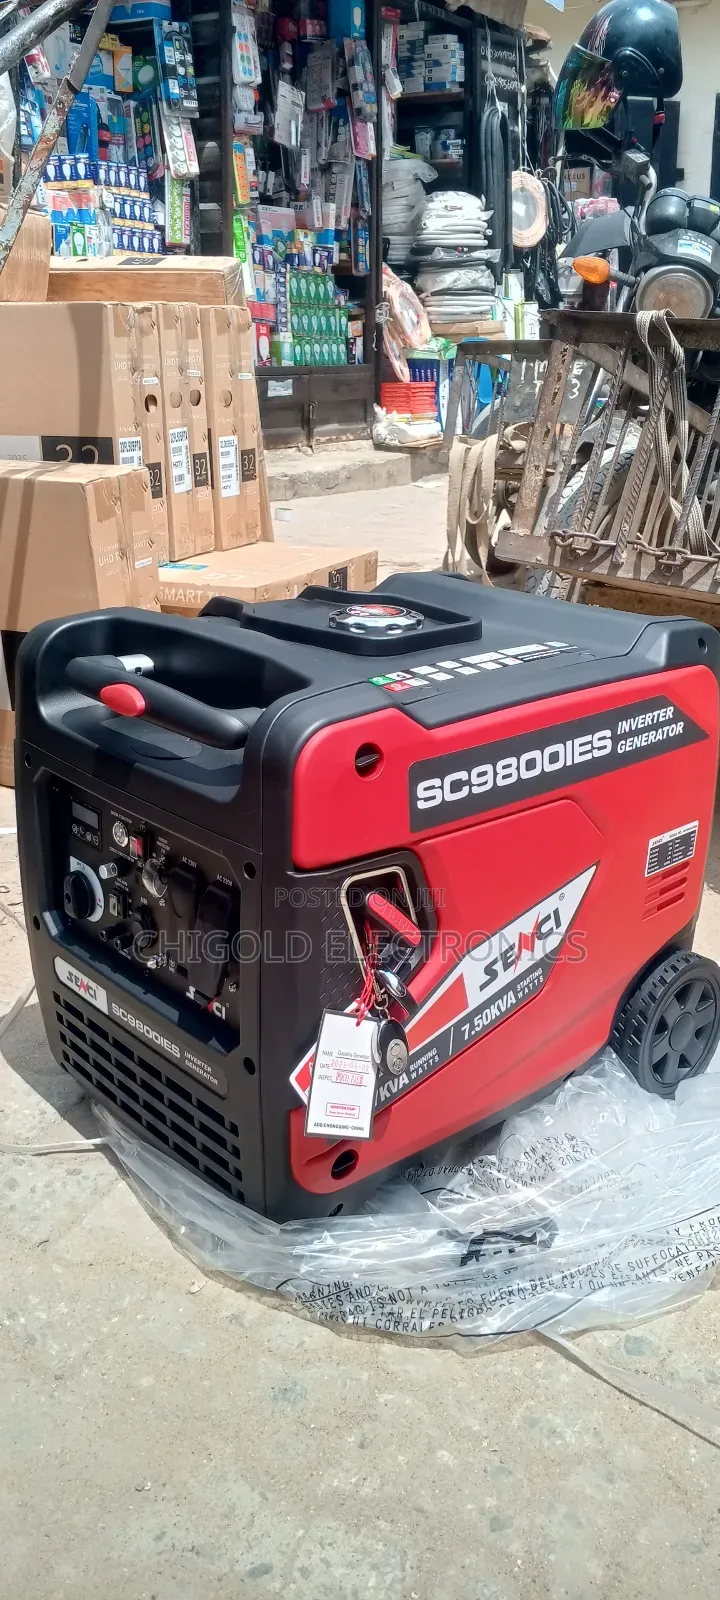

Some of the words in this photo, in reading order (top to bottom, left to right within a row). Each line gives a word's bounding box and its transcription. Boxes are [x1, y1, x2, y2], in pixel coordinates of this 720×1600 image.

[195, 458, 207, 476] 32
[242, 453, 255, 471] 32
[159, 586, 202, 604] SMART
[617, 721, 684, 755] GENERATOR
[416, 729, 612, 810] SC9800IES
[616, 706, 674, 735] INVERTER
[479, 906, 562, 992] SENCI
[66, 970, 98, 1001] SENCI
[516, 967, 543, 992] STARTING
[461, 990, 517, 1041] 7.50KVA
[517, 975, 544, 1000] WATTS
[111, 1001, 181, 1059] SC9800IES
[184, 1050, 213, 1074] INVERTER
[319, 1062, 330, 1070] DATE
[409, 1047, 438, 1072] RUNNING
[410, 1055, 440, 1080] WATTS
[185, 1059, 219, 1086] GENERATOR
[674, 1255, 693, 1268] NE
[349, 1285, 372, 1302] AND
[368, 1297, 385, 1312] IS
[388, 1287, 413, 1306] NOT
